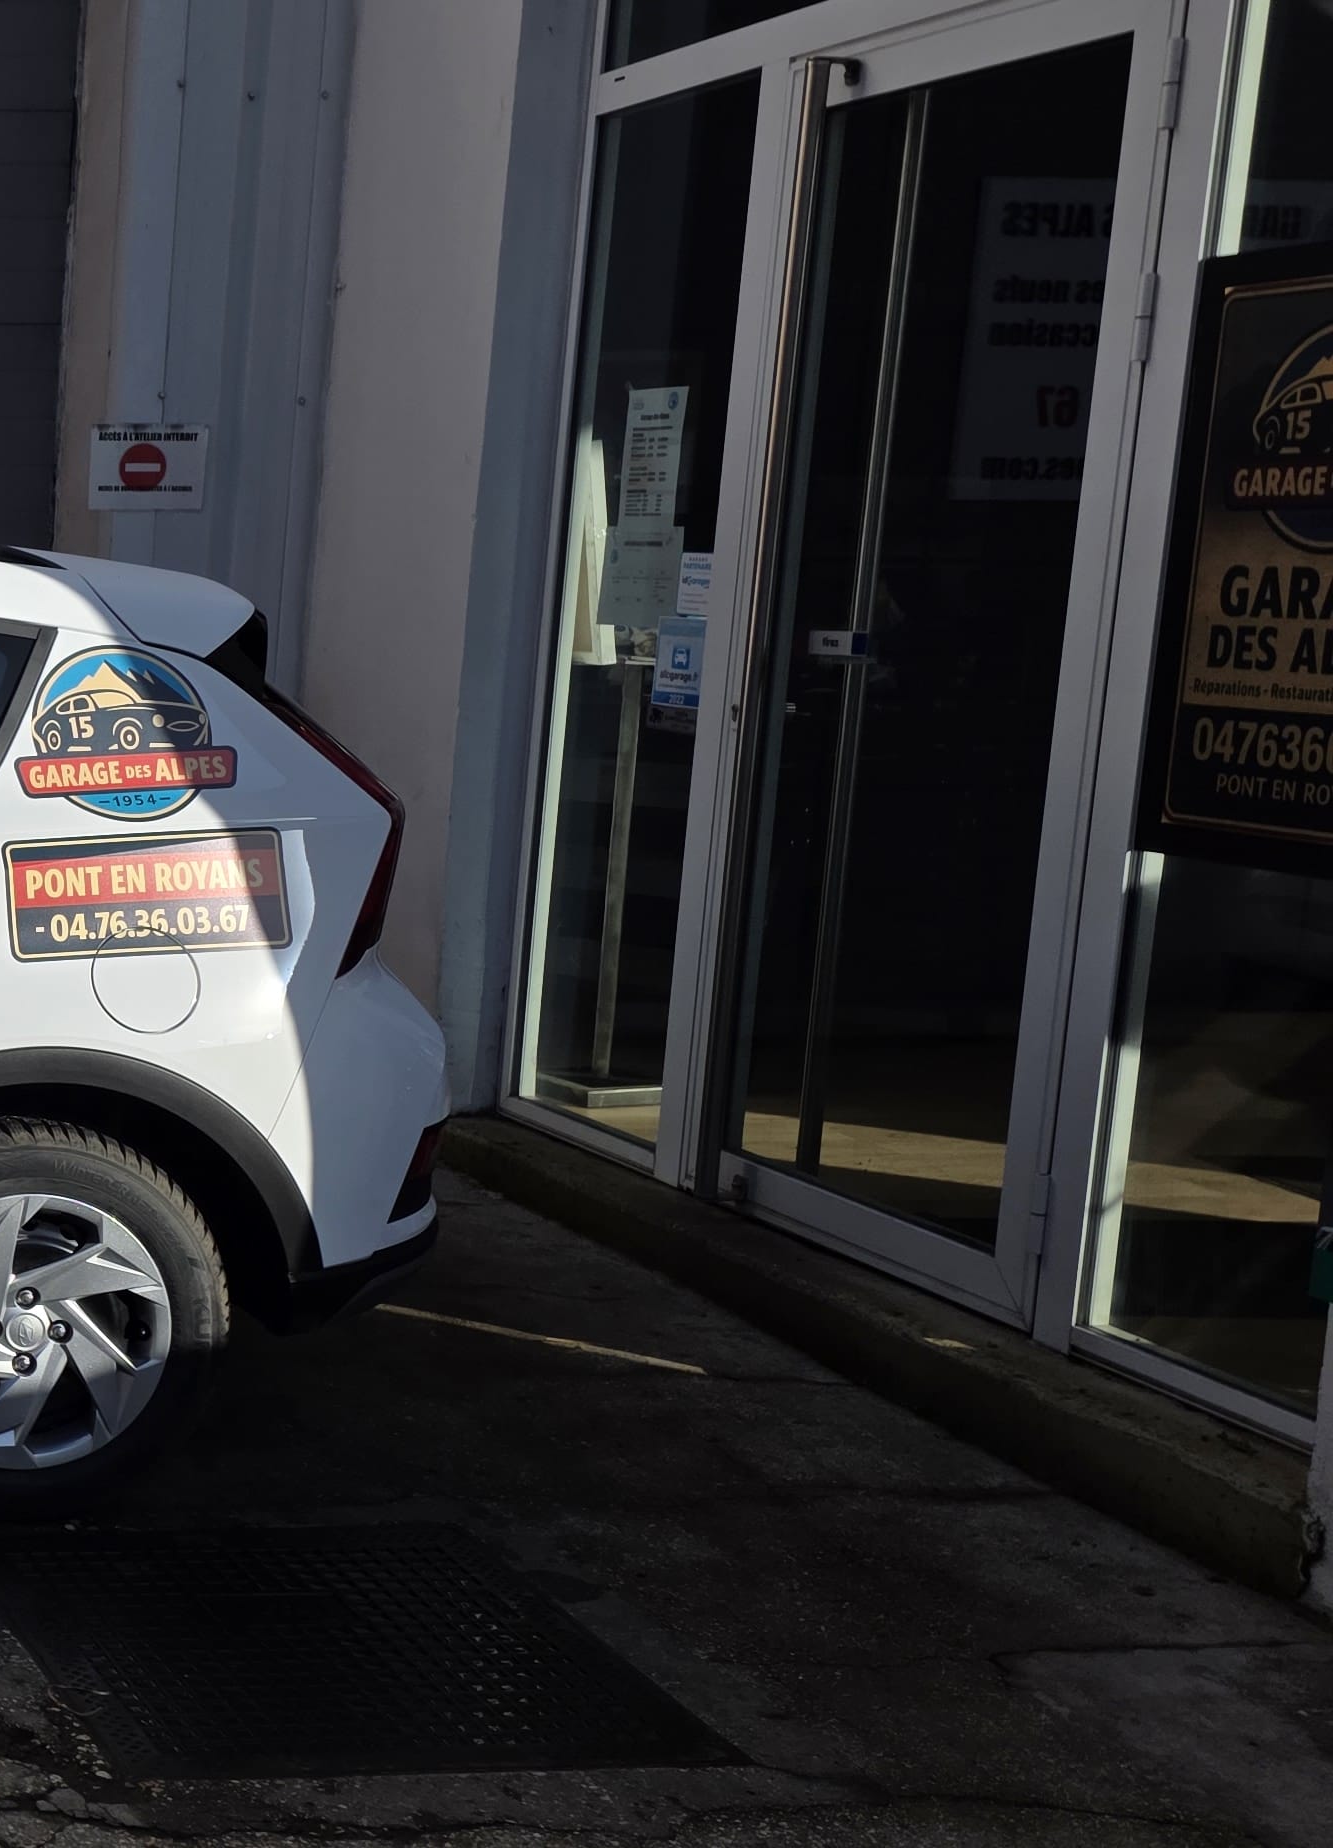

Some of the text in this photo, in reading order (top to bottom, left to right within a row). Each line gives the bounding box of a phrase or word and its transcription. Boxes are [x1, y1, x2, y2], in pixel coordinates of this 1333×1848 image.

[1286, 410, 1313, 441] 15
[1233, 464, 1328, 498] GARAGE
[1206, 624, 1278, 672] DES
[1193, 677, 1261, 698] Réparations
[68, 715, 95, 740] 15
[29, 755, 228, 790] GARAGE DES ALPES
[111, 793, 158, 808] 1954
[1215, 773, 1333, 806] PONT EN RO
[25, 857, 265, 900] PONT EN ROYANS
[49, 904, 250, 944] 04.76.36.03.67
